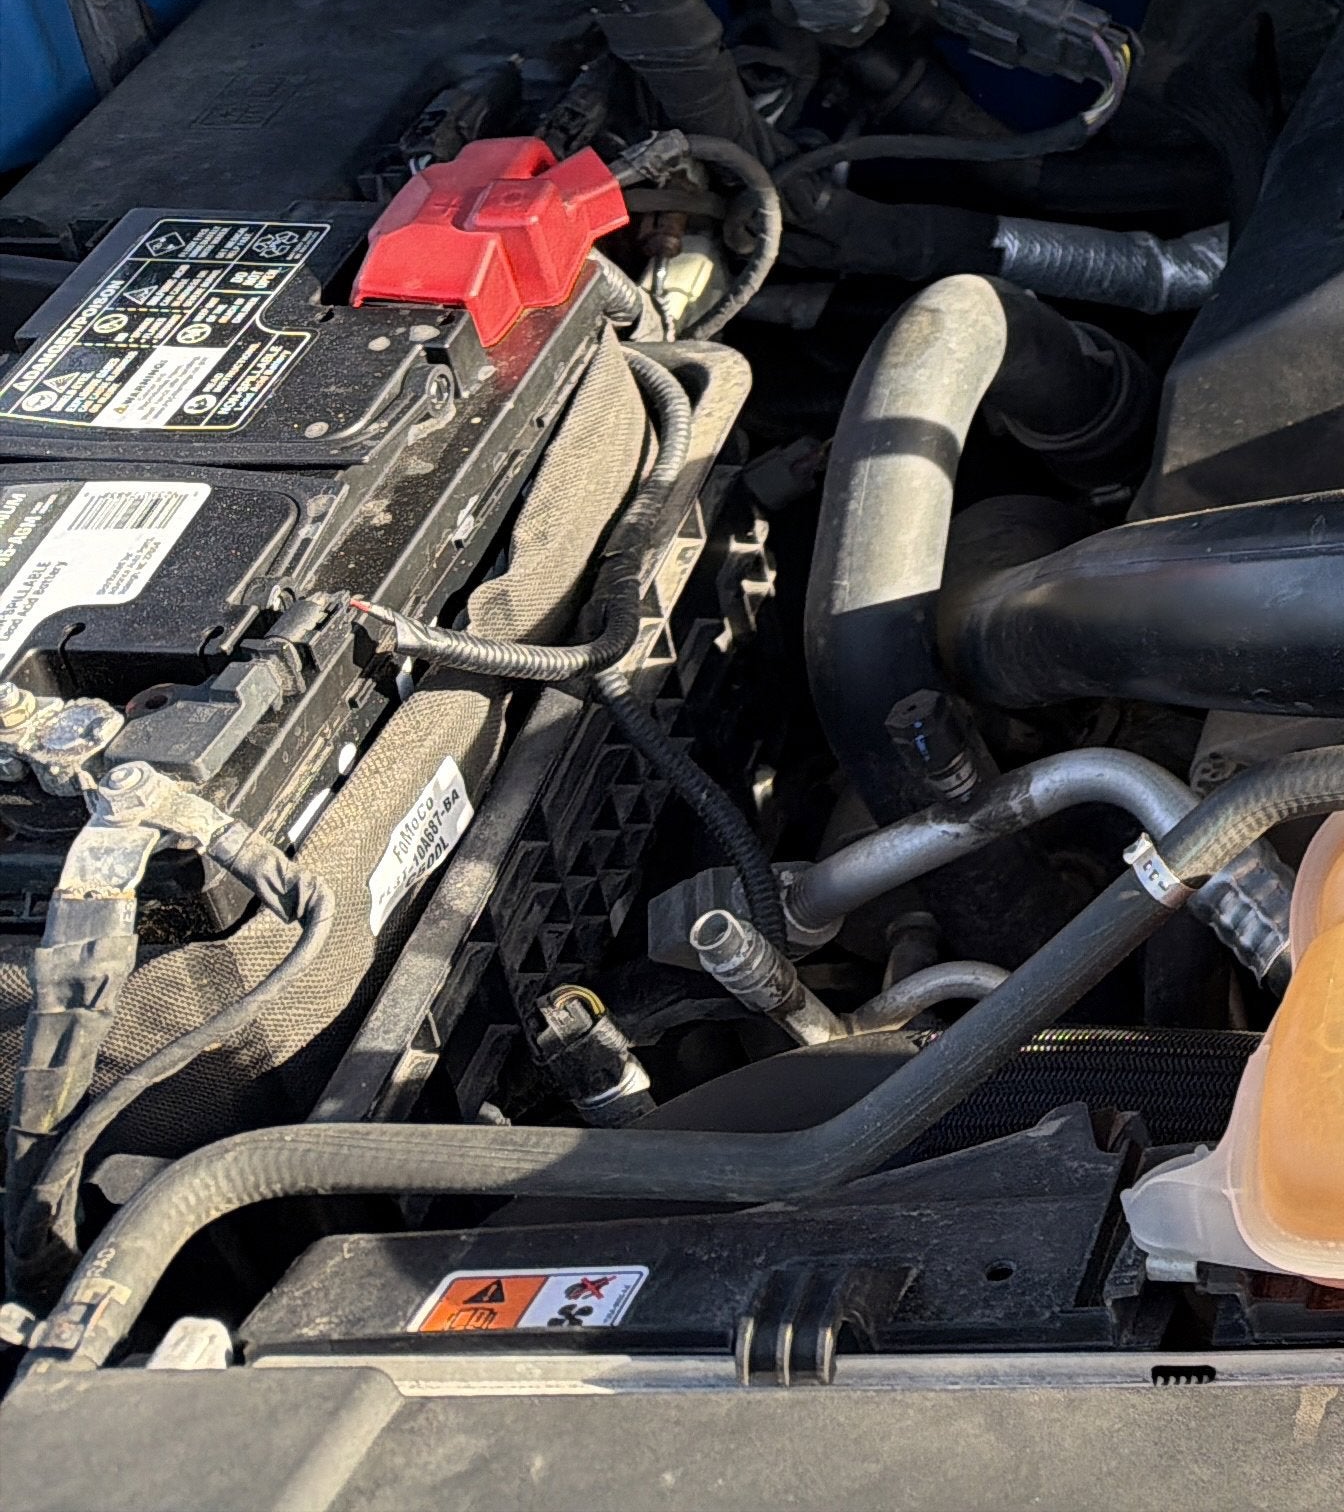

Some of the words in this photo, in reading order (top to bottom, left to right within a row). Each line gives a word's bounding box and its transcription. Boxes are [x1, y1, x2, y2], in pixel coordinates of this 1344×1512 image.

[228, 272, 250, 282] DO
[241, 270, 265, 285] NOT
[24, 280, 125, 379] DANGER/POISON
[217, 345, 285, 414] NON-SPILLABLE
[392, 796, 435, 865] FoMoCo
